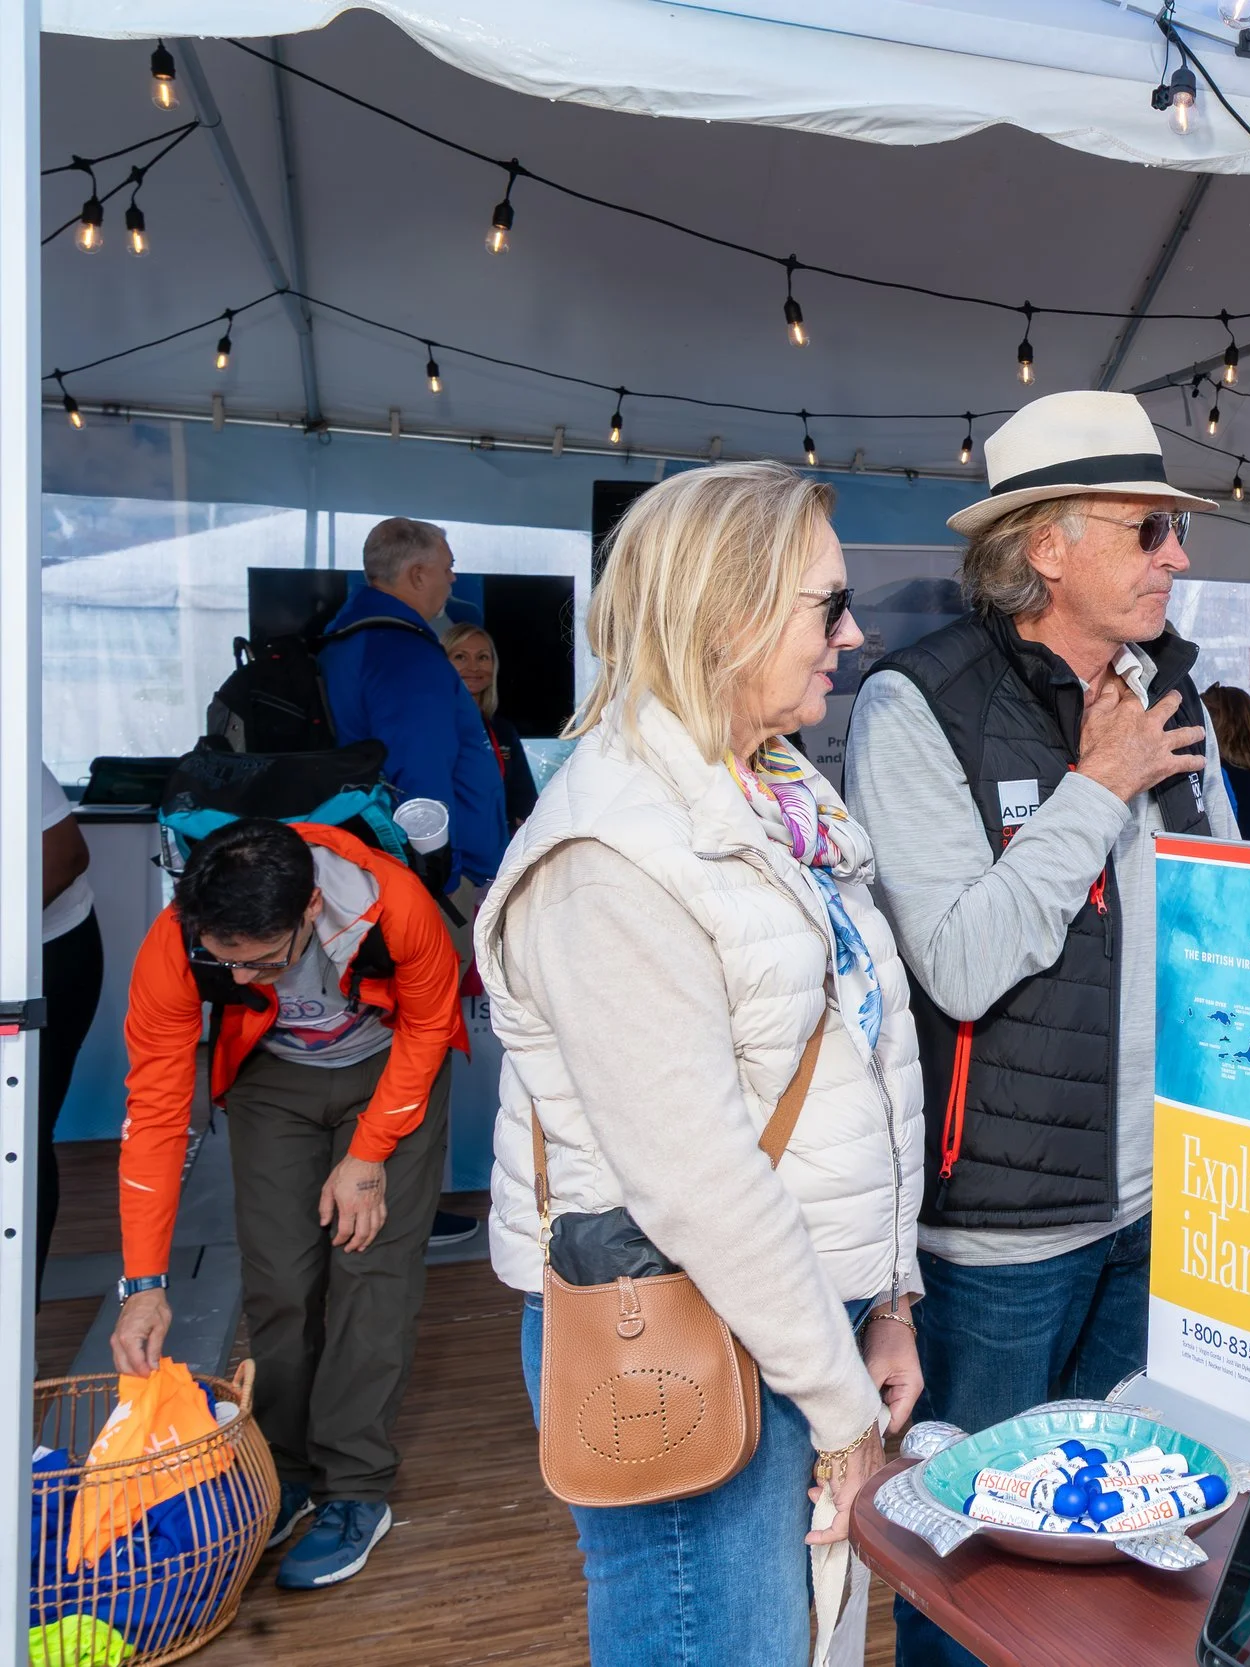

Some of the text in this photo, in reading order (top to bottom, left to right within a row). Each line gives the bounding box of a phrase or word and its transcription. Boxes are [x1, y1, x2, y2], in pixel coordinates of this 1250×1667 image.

[816, 752, 842, 764] and
[1184, 948, 1200, 961] THE
[1202, 952, 1234, 966] BRITISH
[978, 1473, 1032, 1498] BRITISH
